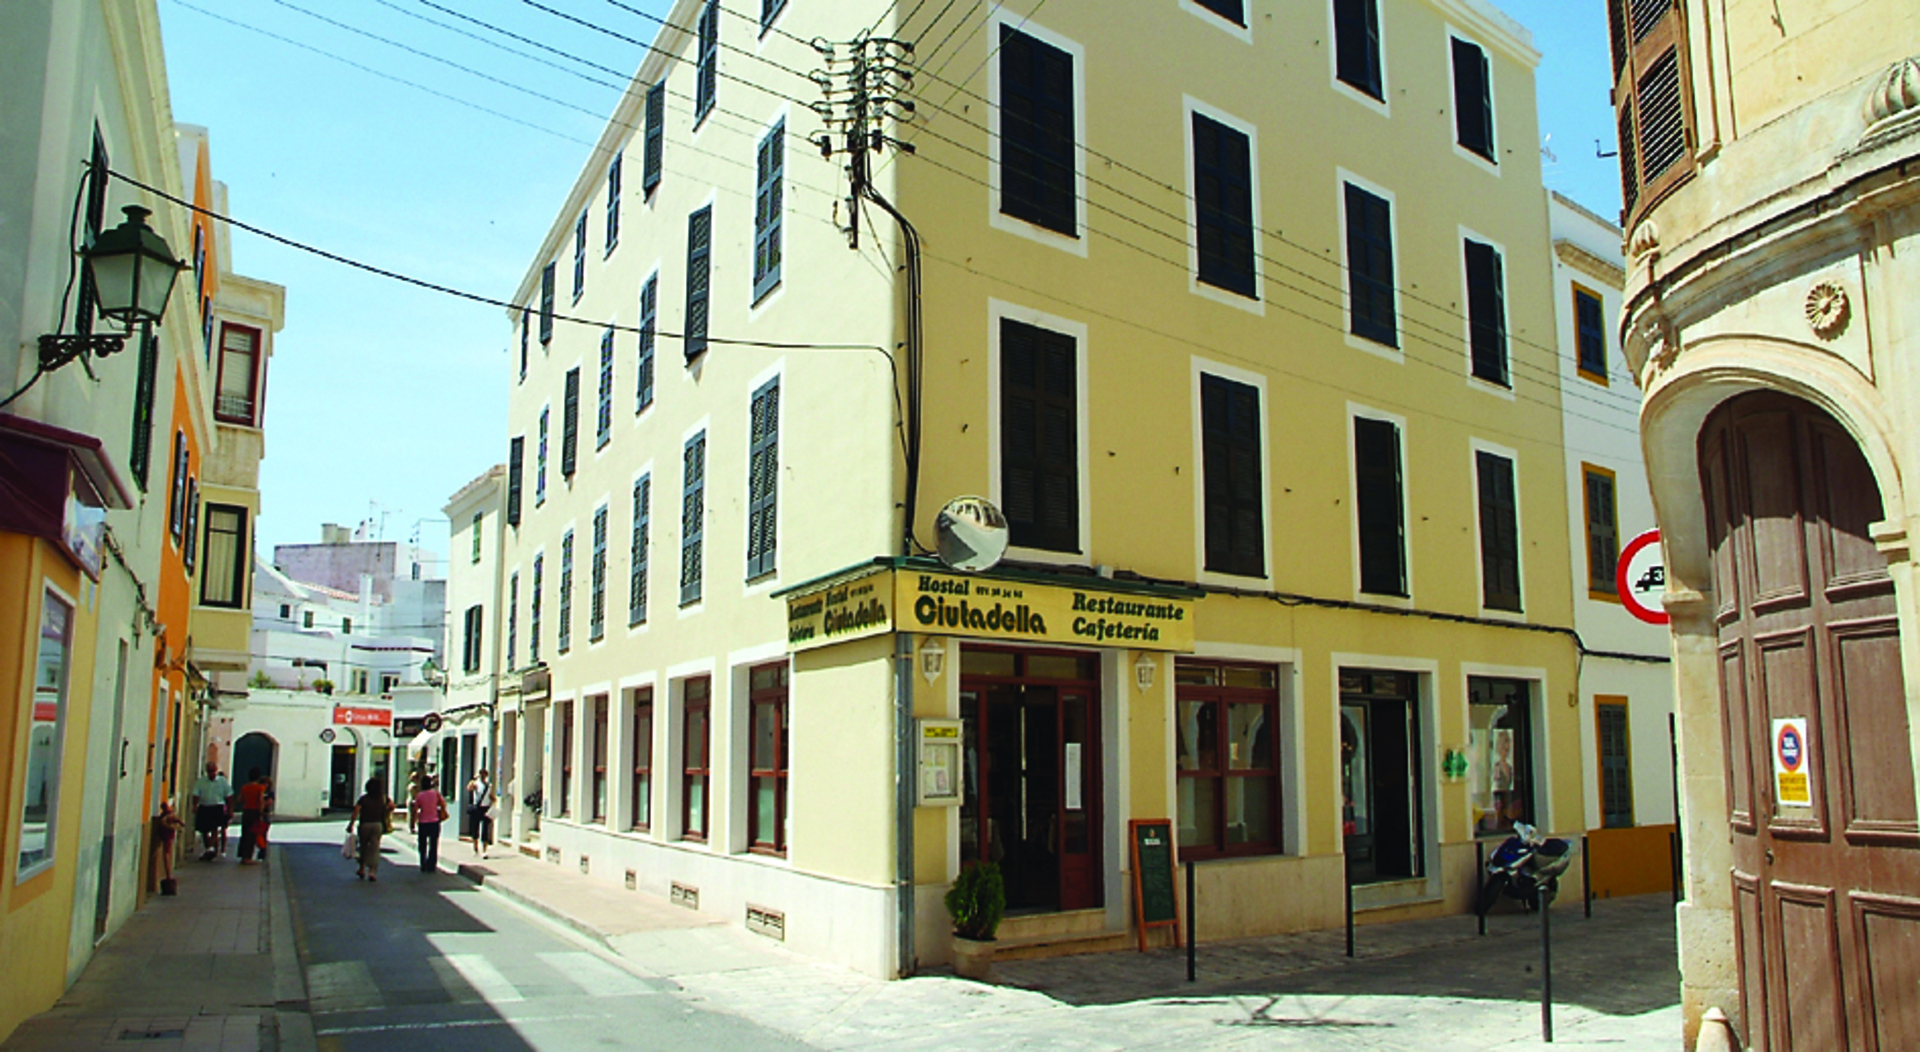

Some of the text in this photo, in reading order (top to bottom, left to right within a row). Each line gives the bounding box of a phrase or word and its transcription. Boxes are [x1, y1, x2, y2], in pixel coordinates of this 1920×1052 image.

[918, 575, 970, 595] Hostal
[914, 594, 1047, 634] Ciutadella
[1072, 591, 1184, 620] Restaurante
[1072, 616, 1159, 641] Cafetería
